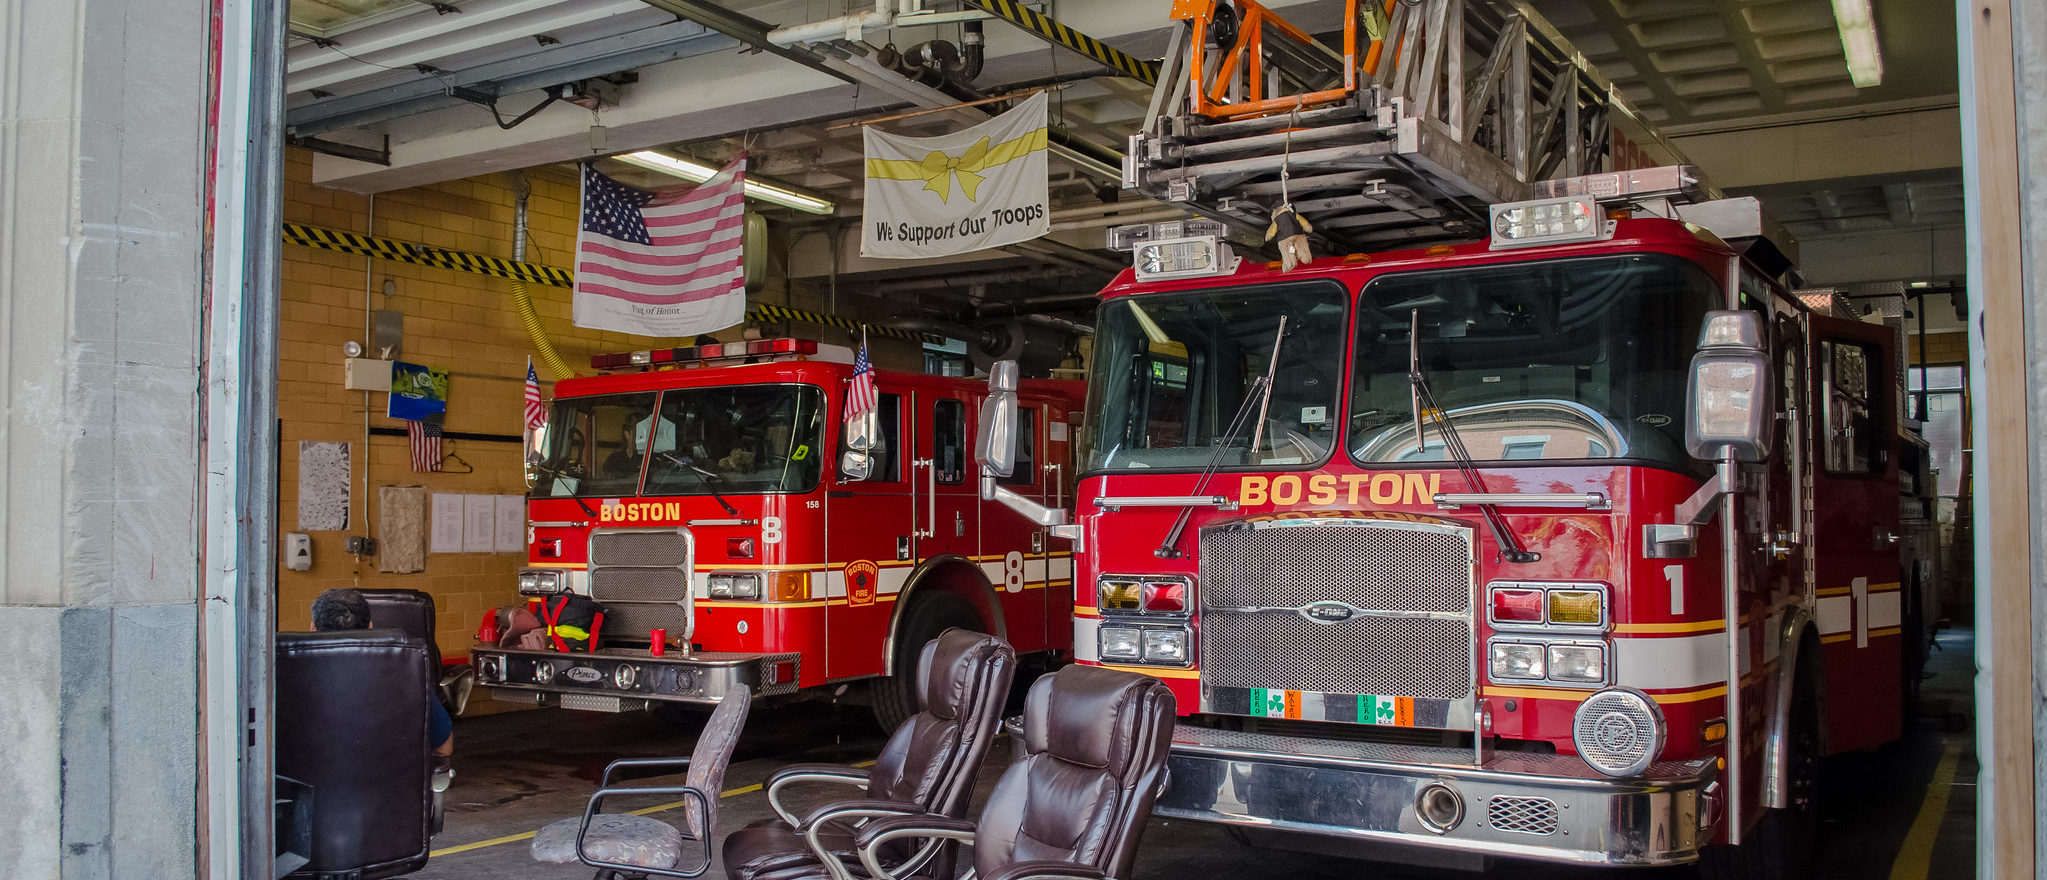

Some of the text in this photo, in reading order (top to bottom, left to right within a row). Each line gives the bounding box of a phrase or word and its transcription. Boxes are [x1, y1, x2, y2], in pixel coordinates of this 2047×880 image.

[877, 203, 1043, 246] We Support Our Troops
[646, 306, 656, 315] of
[657, 307, 680, 315] Honor
[1239, 473, 1440, 506] BOSTON
[600, 503, 680, 521] BOSTON
[762, 517, 782, 544] 8
[848, 563, 875, 577] BOSTON
[1006, 551, 1023, 593] 8
[1663, 565, 1684, 614] 1
[1852, 577, 1867, 648] 1
